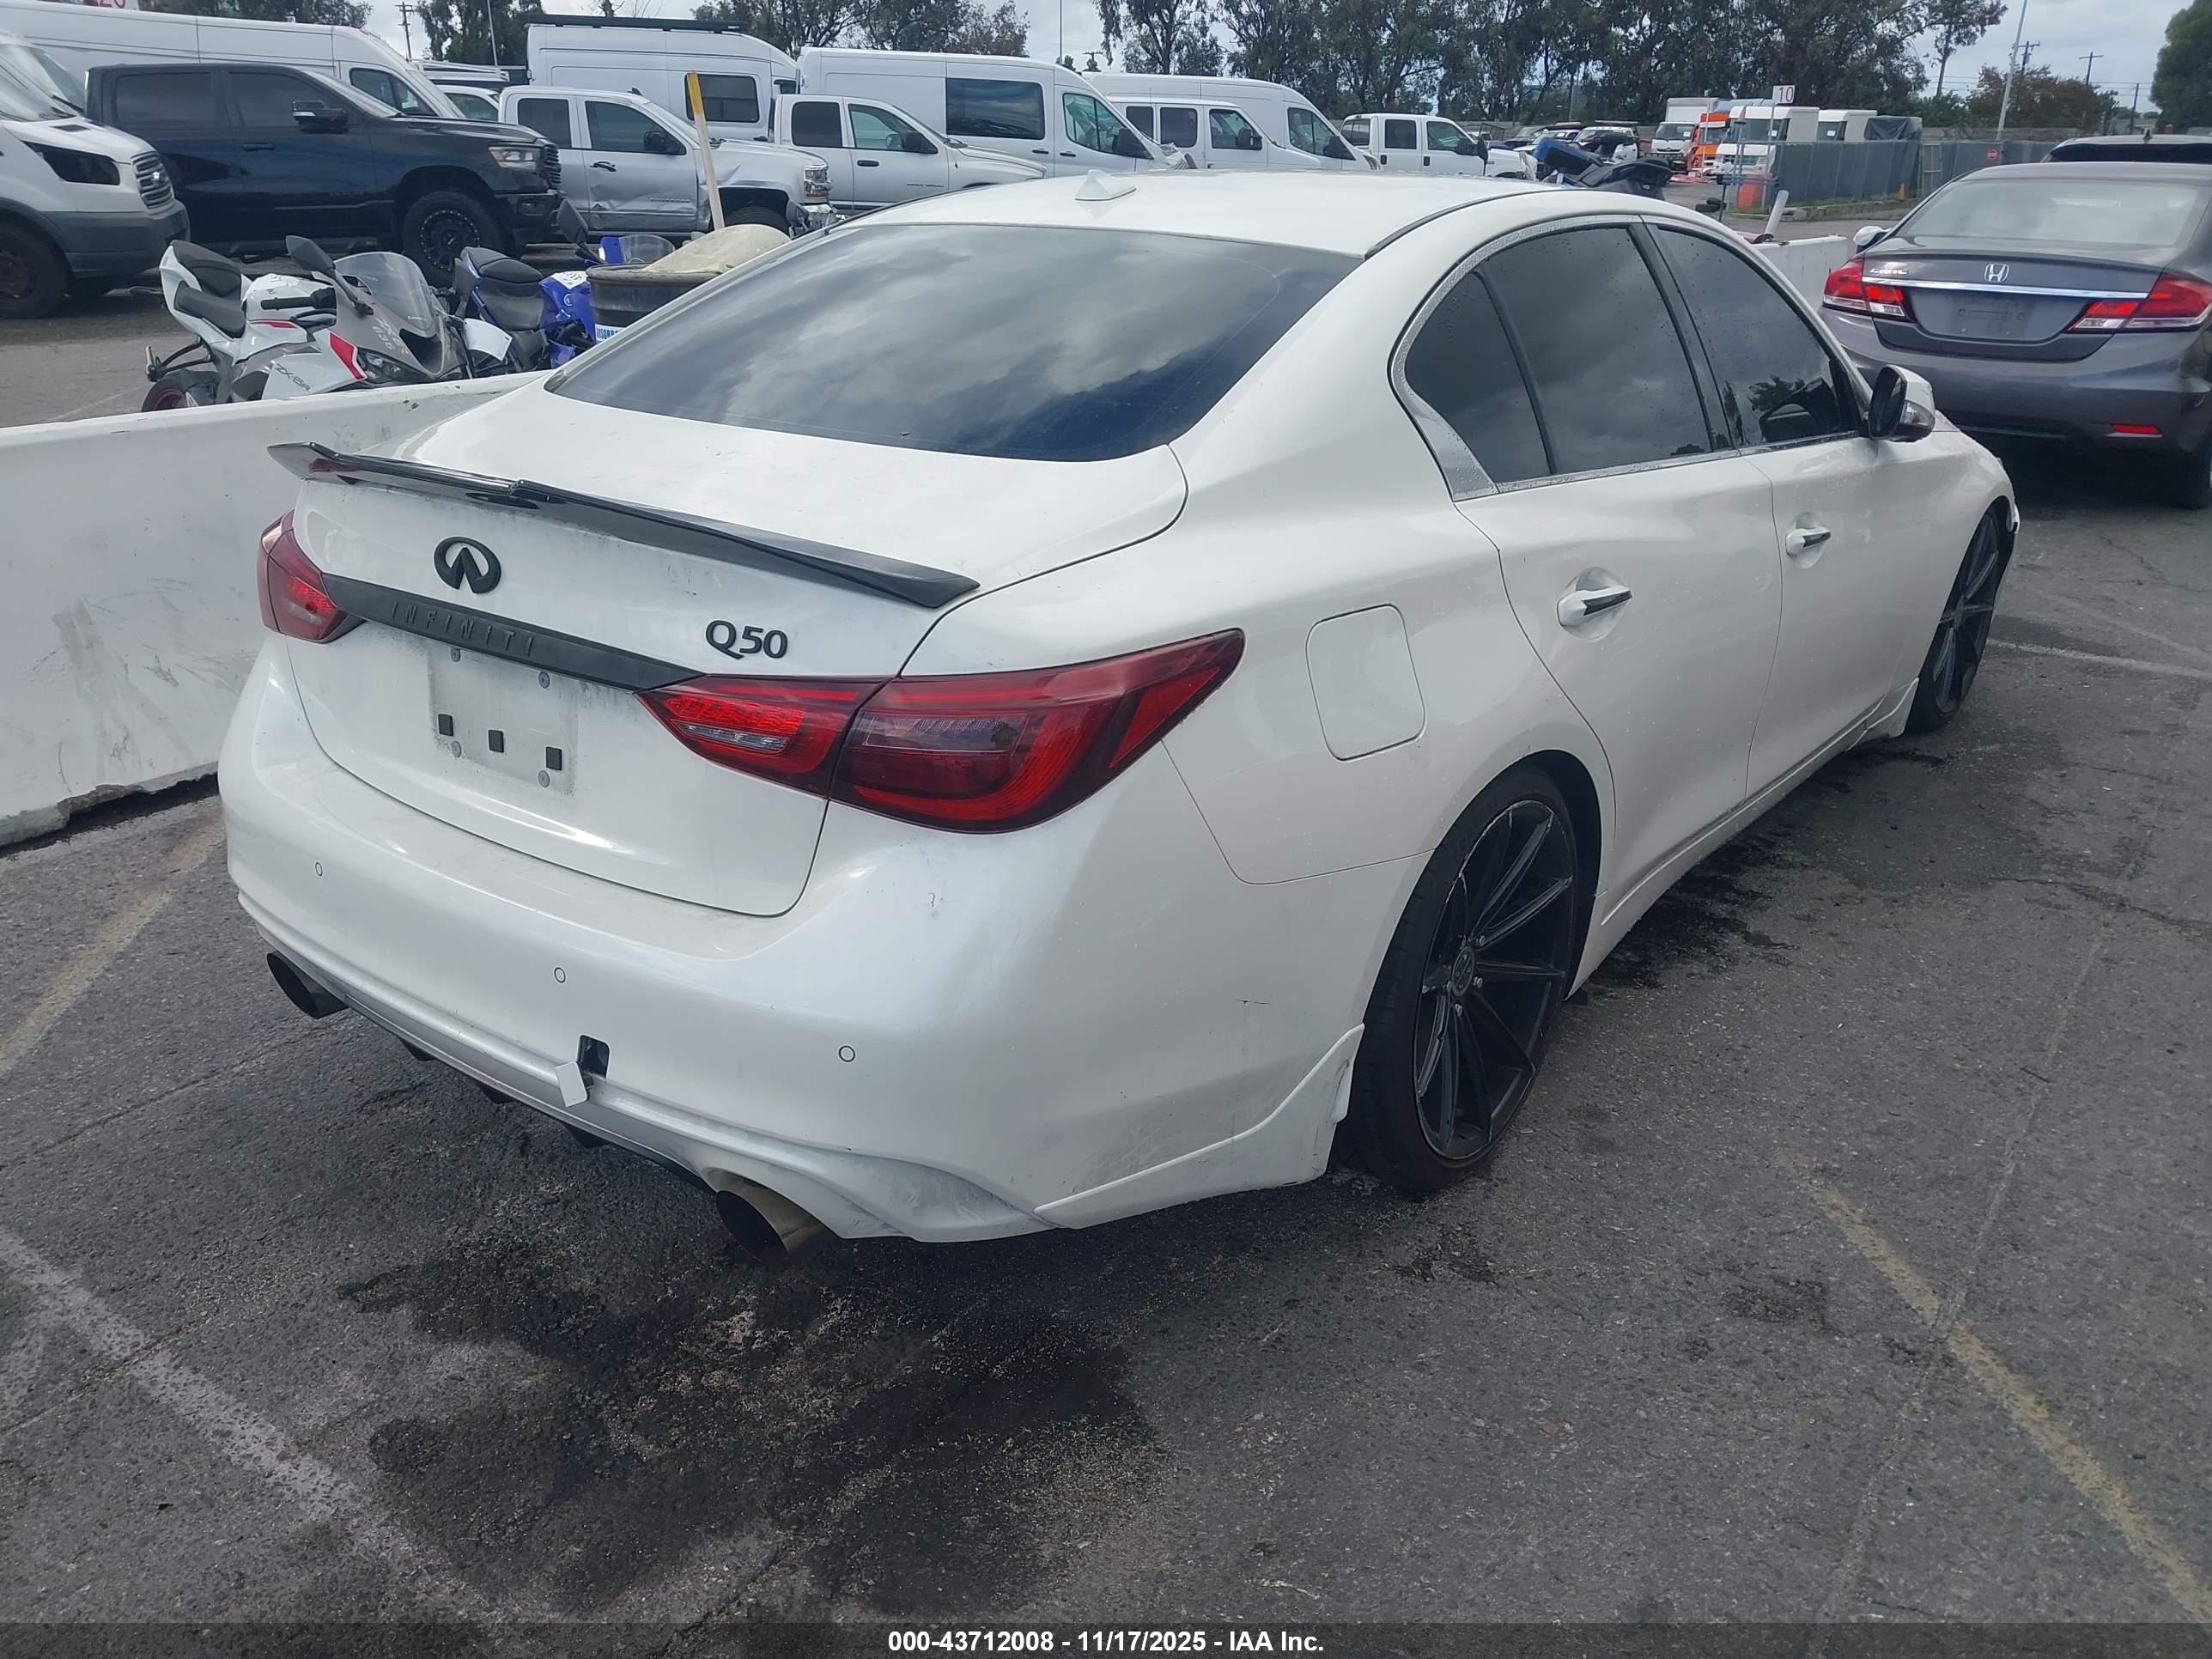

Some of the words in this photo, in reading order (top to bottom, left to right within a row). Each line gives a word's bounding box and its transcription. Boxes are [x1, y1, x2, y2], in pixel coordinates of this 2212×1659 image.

[1779, 87, 1794, 102] 10
[276, 363, 311, 392] ZX-6R
[392, 600, 534, 657] INFINITI
[706, 620, 787, 659] Q50
